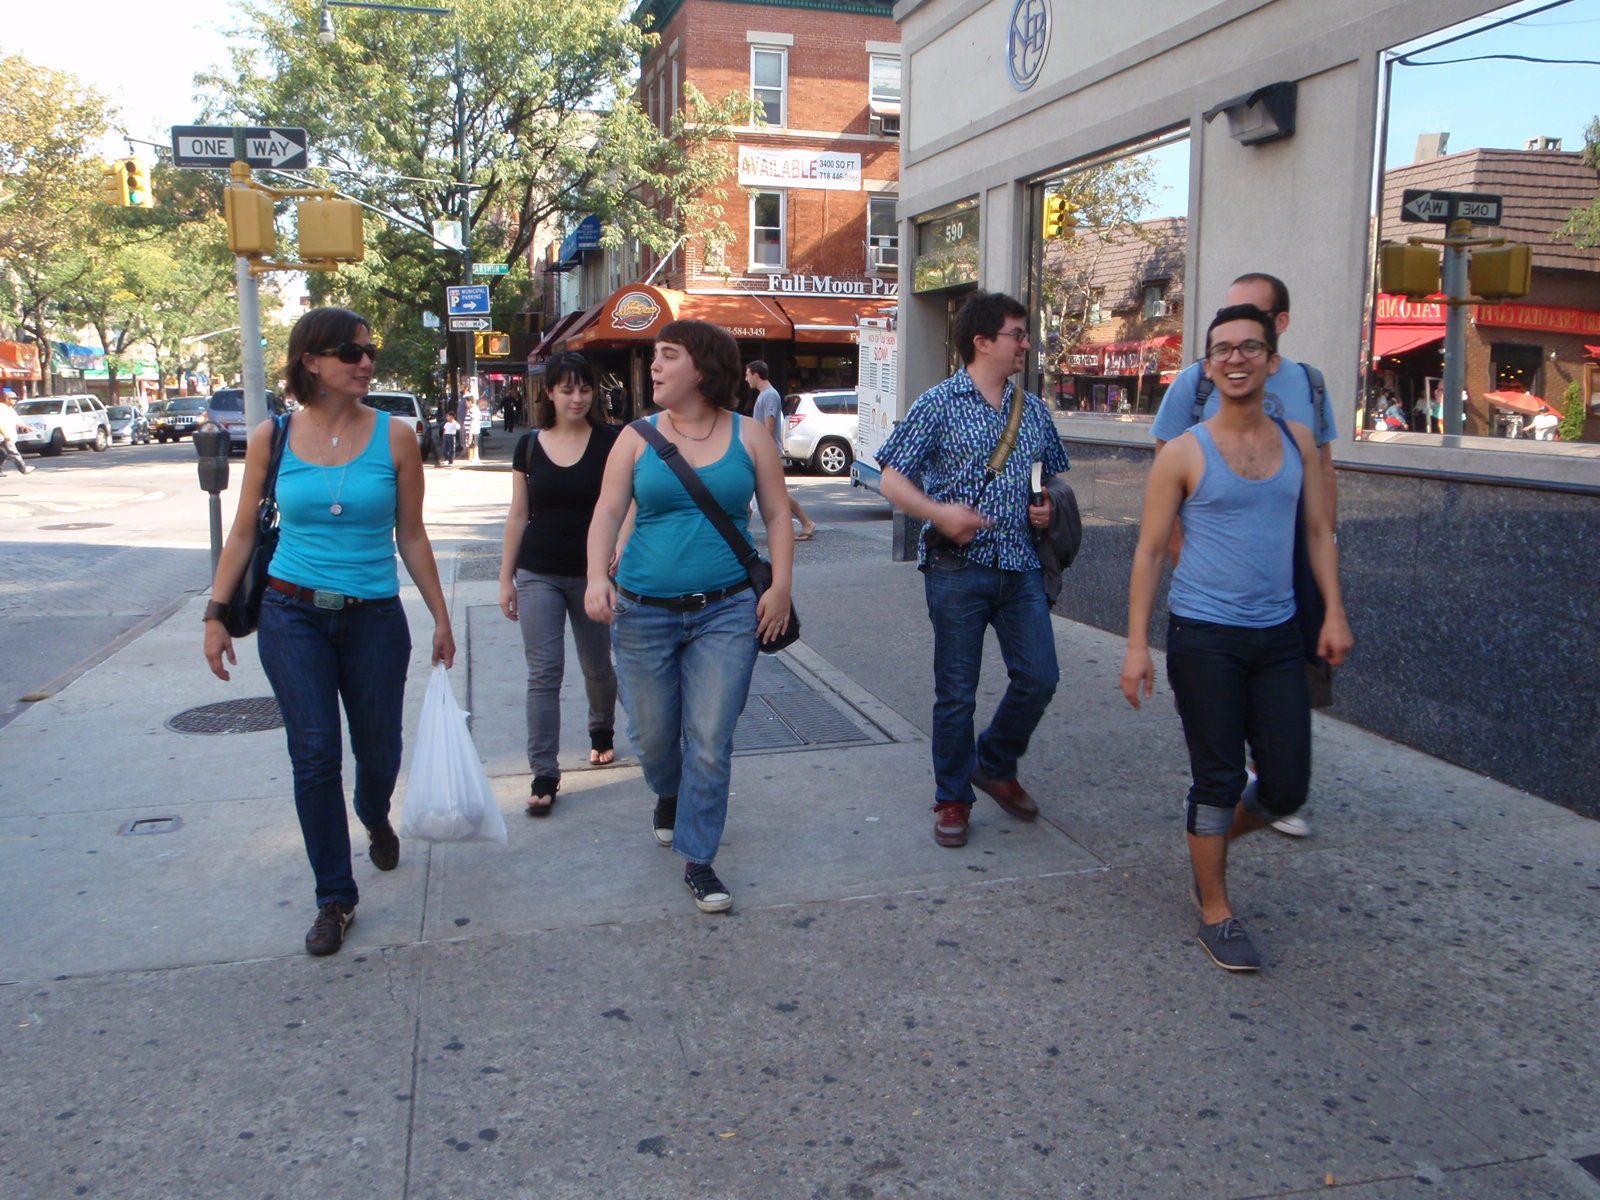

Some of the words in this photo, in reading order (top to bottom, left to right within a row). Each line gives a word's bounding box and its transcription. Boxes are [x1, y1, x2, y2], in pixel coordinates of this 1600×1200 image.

[191, 139, 229, 156] ONE
[253, 140, 290, 157] WAY
[741, 154, 817, 180] AVAILABLE
[819, 160, 834, 169] 3400
[835, 160, 846, 169] SQ
[846, 161, 855, 170] FT
[819, 172, 831, 181] 718
[945, 222, 963, 242] 590
[767, 274, 806, 292] Full
[811, 275, 865, 294] Moon
[451, 296, 460, 308] P
